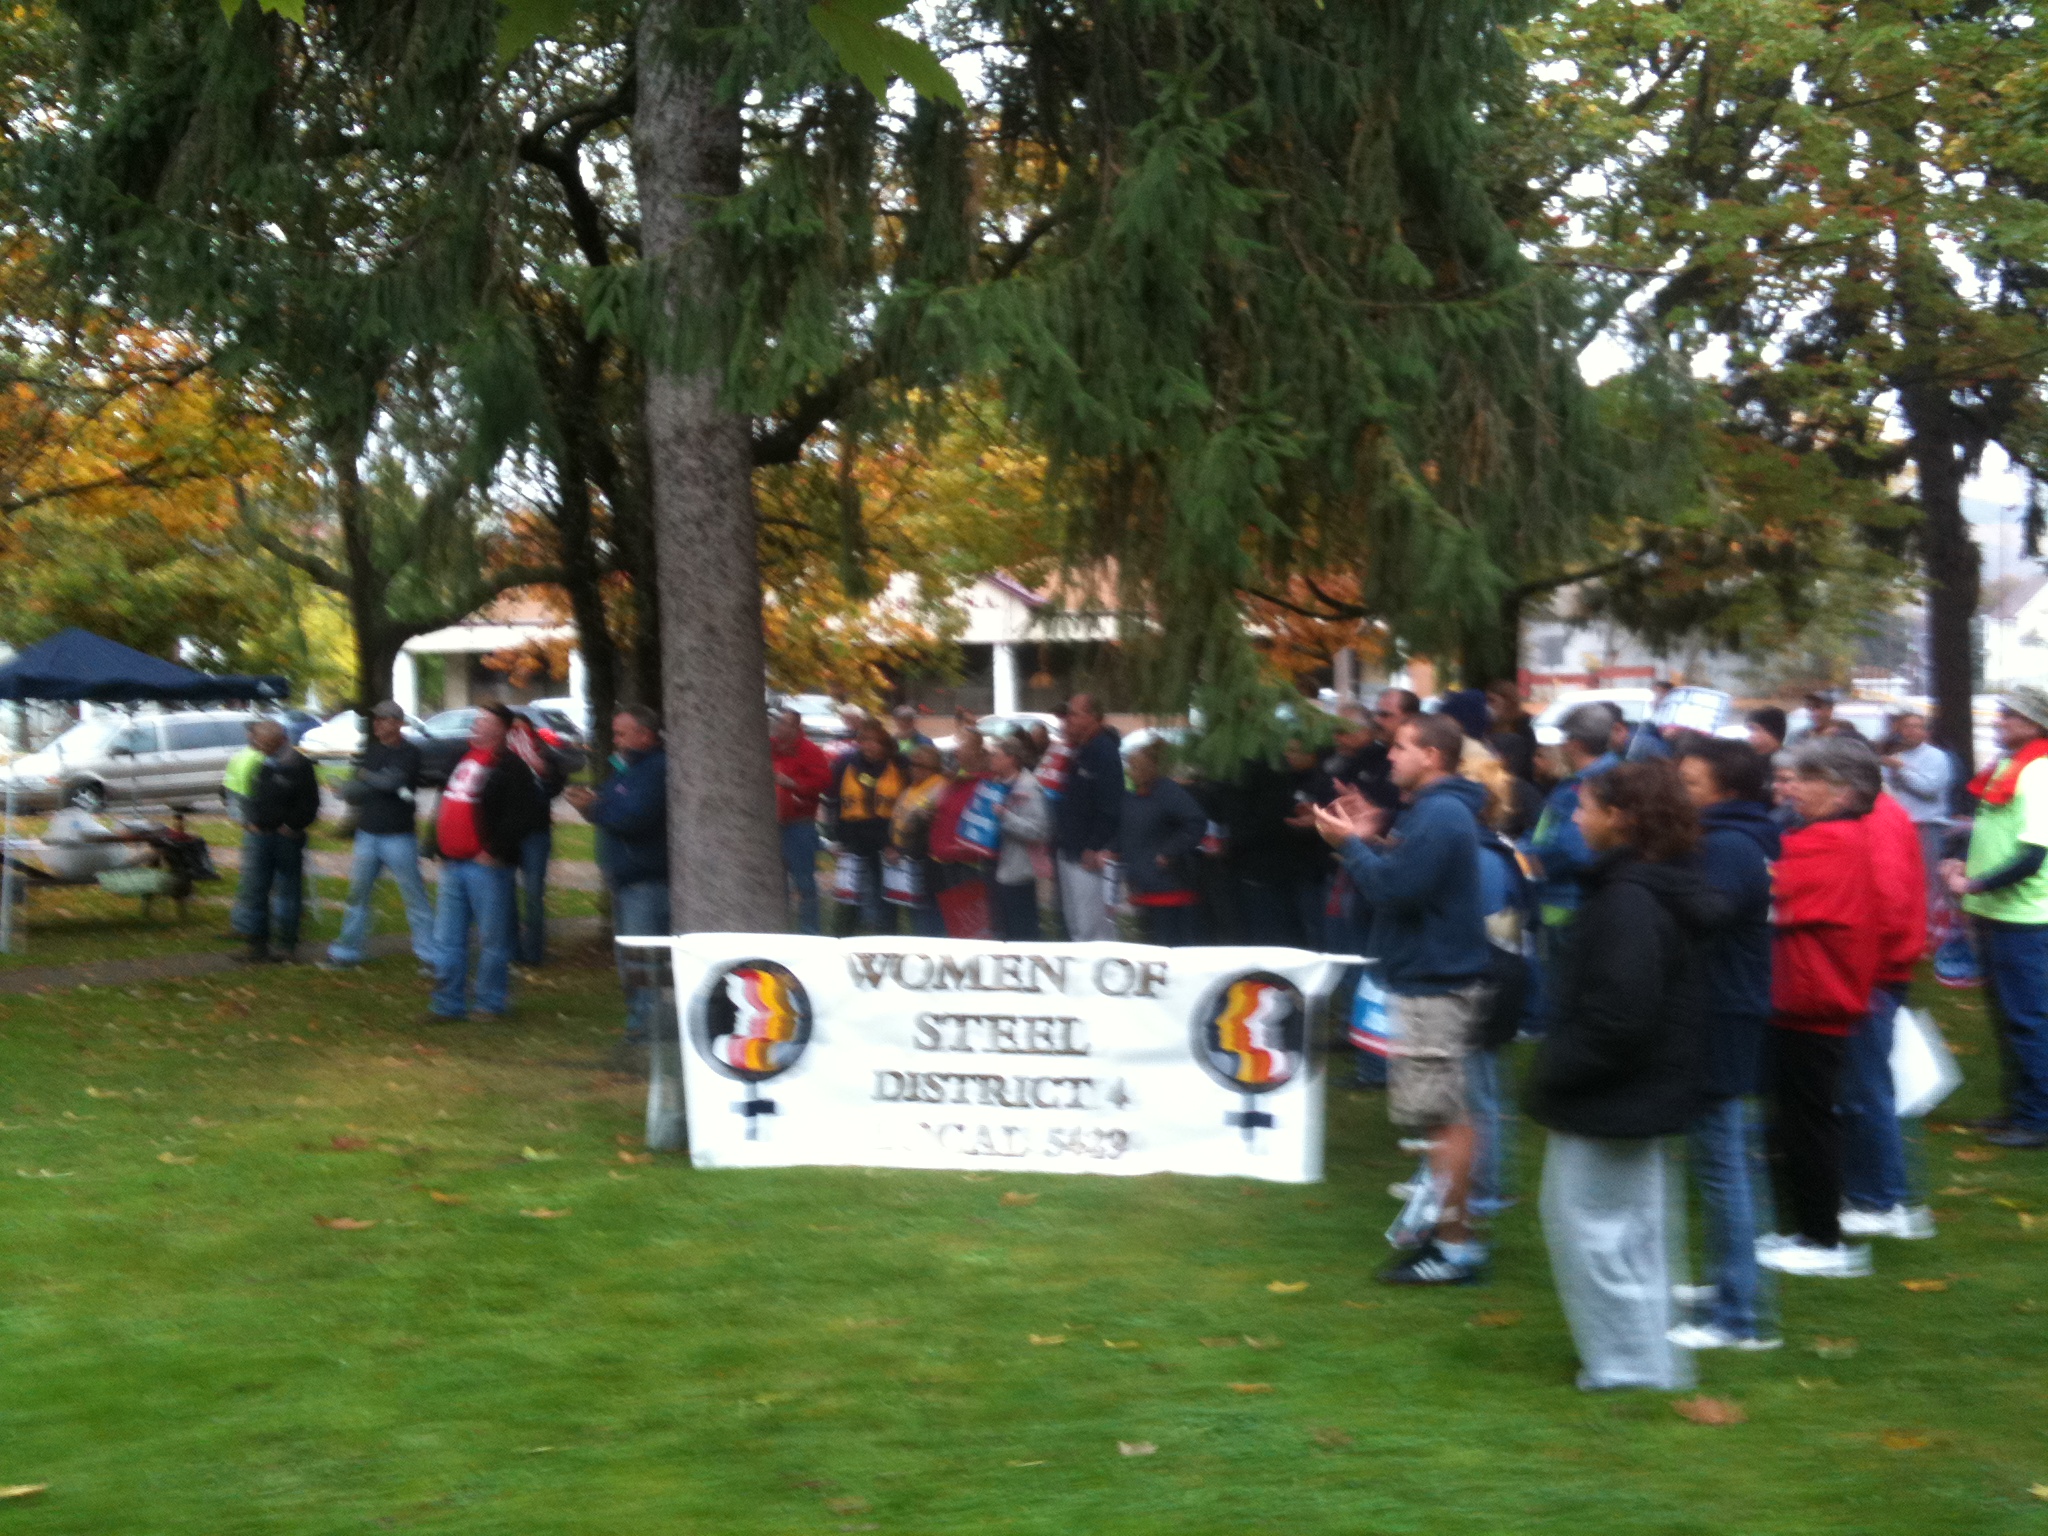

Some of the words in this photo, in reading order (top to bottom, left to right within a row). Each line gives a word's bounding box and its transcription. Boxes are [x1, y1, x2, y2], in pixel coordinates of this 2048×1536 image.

[847, 953, 1075, 992] WOMEN
[1091, 958, 1170, 997] OF
[912, 1013, 1090, 1055] STEEL
[873, 1071, 1094, 1109] DISTRICT
[875, 1121, 1028, 1157] CAL
